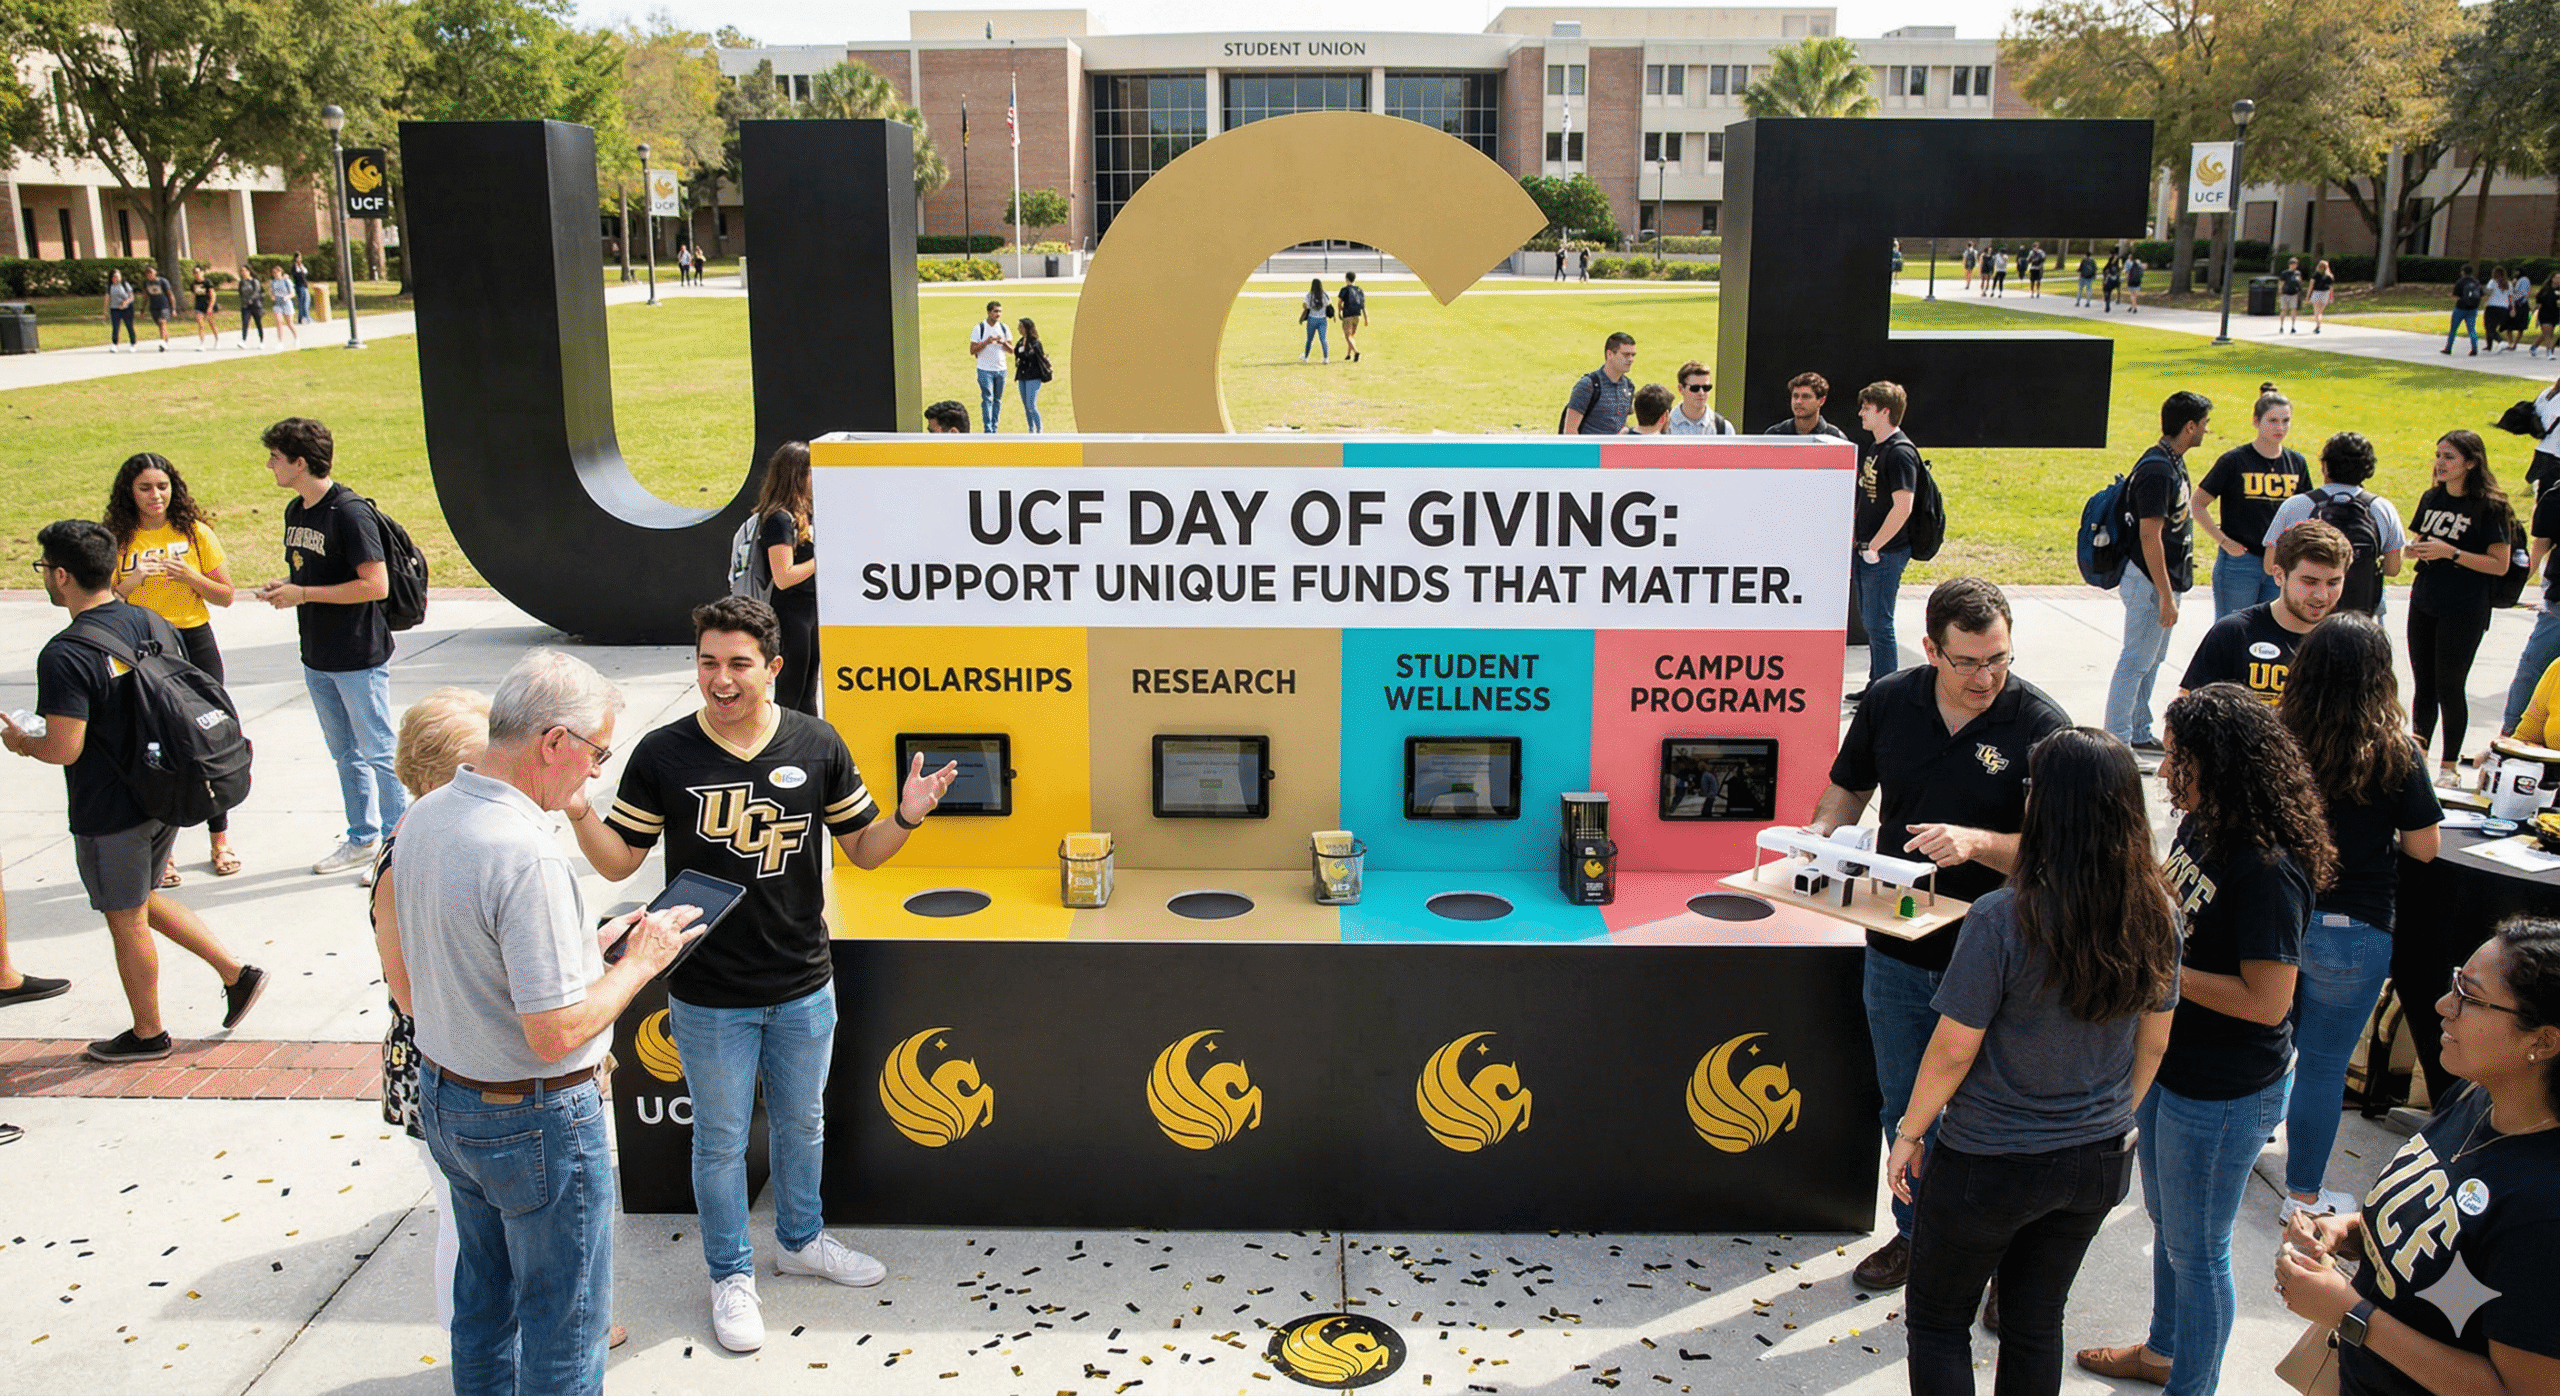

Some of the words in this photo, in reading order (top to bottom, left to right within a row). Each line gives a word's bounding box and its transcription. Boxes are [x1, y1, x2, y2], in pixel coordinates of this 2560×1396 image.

[1224, 42, 1301, 56] STUDENT
[1308, 42, 1366, 56] UNION
[350, 196, 384, 210] UCF
[2195, 191, 2224, 203] UCF
[2241, 472, 2299, 497] UCF
[968, 489, 1105, 546] UCF
[1129, 490, 1269, 546] DAY
[1290, 489, 1386, 547] OF
[1408, 490, 1678, 548] GIVING:
[2420, 509, 2472, 541] UCF
[862, 562, 1080, 602] SUPPORT
[1095, 563, 1277, 603] UNIQUE
[1293, 564, 1450, 603] FUNDS
[1464, 565, 1587, 604] THAT
[1601, 565, 1803, 604] MATTER.
[837, 666, 1072, 693] SCHOLARSHIPS
[1396, 653, 1540, 680] STUDENT
[1654, 654, 1785, 681] CAMPUS
[2249, 662, 2290, 691] UC
[1132, 668, 1296, 695] RESEARCH
[1383, 685, 1551, 712] WELLNESS
[1631, 687, 1806, 713] PROGRAMS
[1975, 742, 2009, 775] UCF
[685, 781, 812, 879] UCF
[636, 1096, 694, 1125] UC
[2365, 1132, 2461, 1283] UCF
